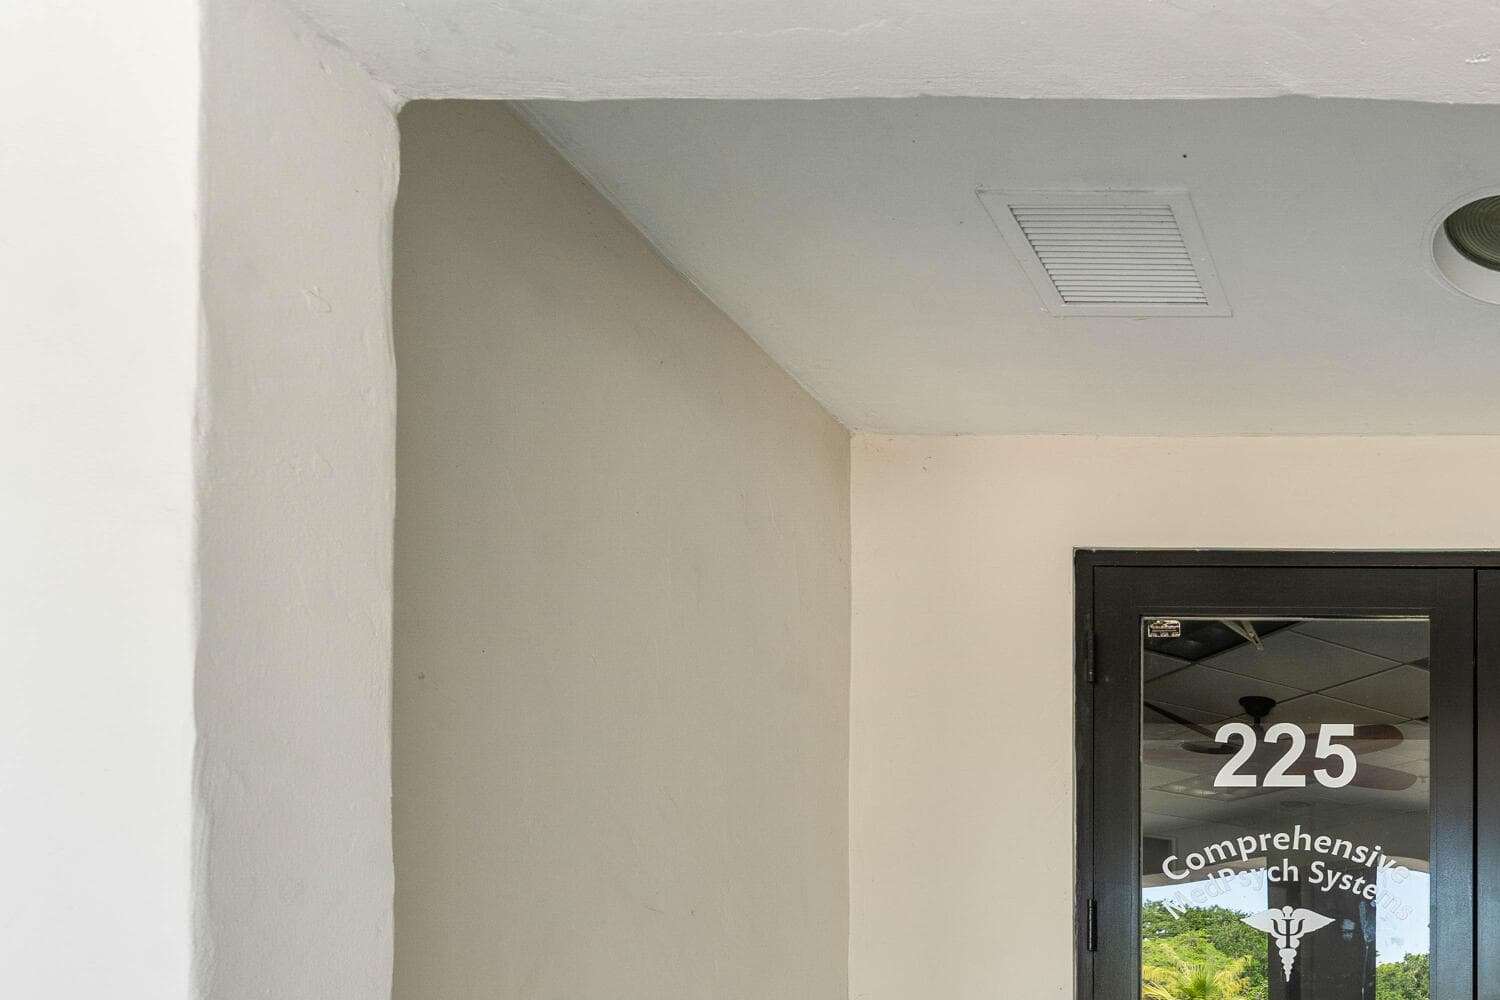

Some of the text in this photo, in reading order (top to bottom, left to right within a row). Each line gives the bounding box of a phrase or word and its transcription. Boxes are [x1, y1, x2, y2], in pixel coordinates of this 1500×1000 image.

[1213, 722, 1357, 788] 225
[1162, 824, 1410, 885] Comprehensive
[1163, 858, 1415, 921] MedPsych Systems
